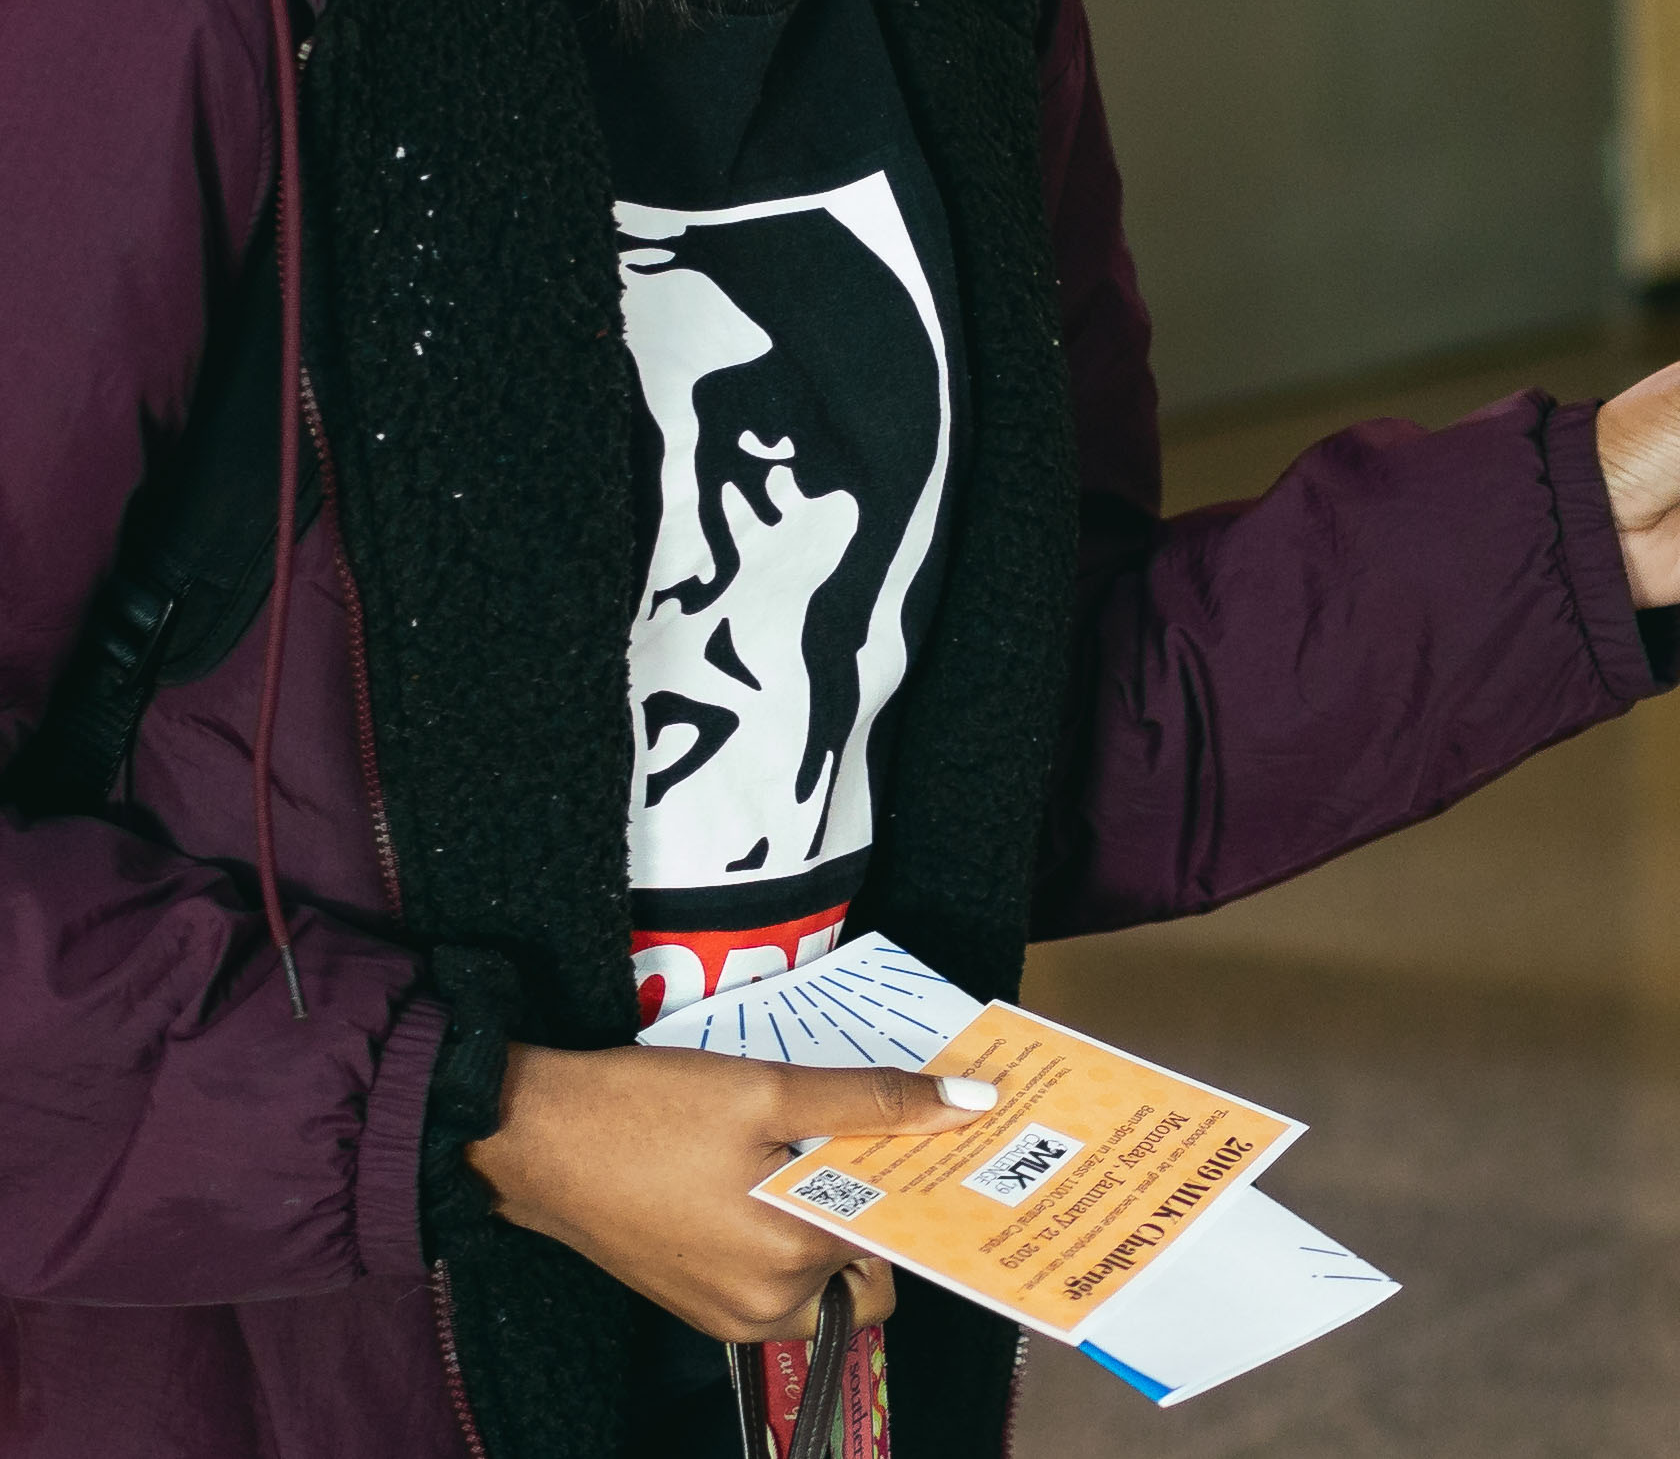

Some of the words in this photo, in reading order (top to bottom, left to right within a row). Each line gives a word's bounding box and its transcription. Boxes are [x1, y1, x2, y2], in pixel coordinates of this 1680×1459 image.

[1107, 1104, 1155, 1145] 8am-5pm
[1113, 1110, 1190, 1168] Monday,
[973, 1132, 1041, 1186] CHALLENGE
[997, 1139, 1066, 1189] MLK
[1071, 1152, 1105, 1178] Zeiss
[1095, 1143, 1116, 1154] in
[1155, 1160, 1174, 1173] be
[1166, 1146, 1186, 1162] can
[1196, 1136, 1253, 1181] 2019
[1051, 1170, 1125, 1229] January
[1151, 1180, 1210, 1223] MLK
[998, 1241, 1040, 1269] 2019
[1064, 1222, 1164, 1300] Challenge
